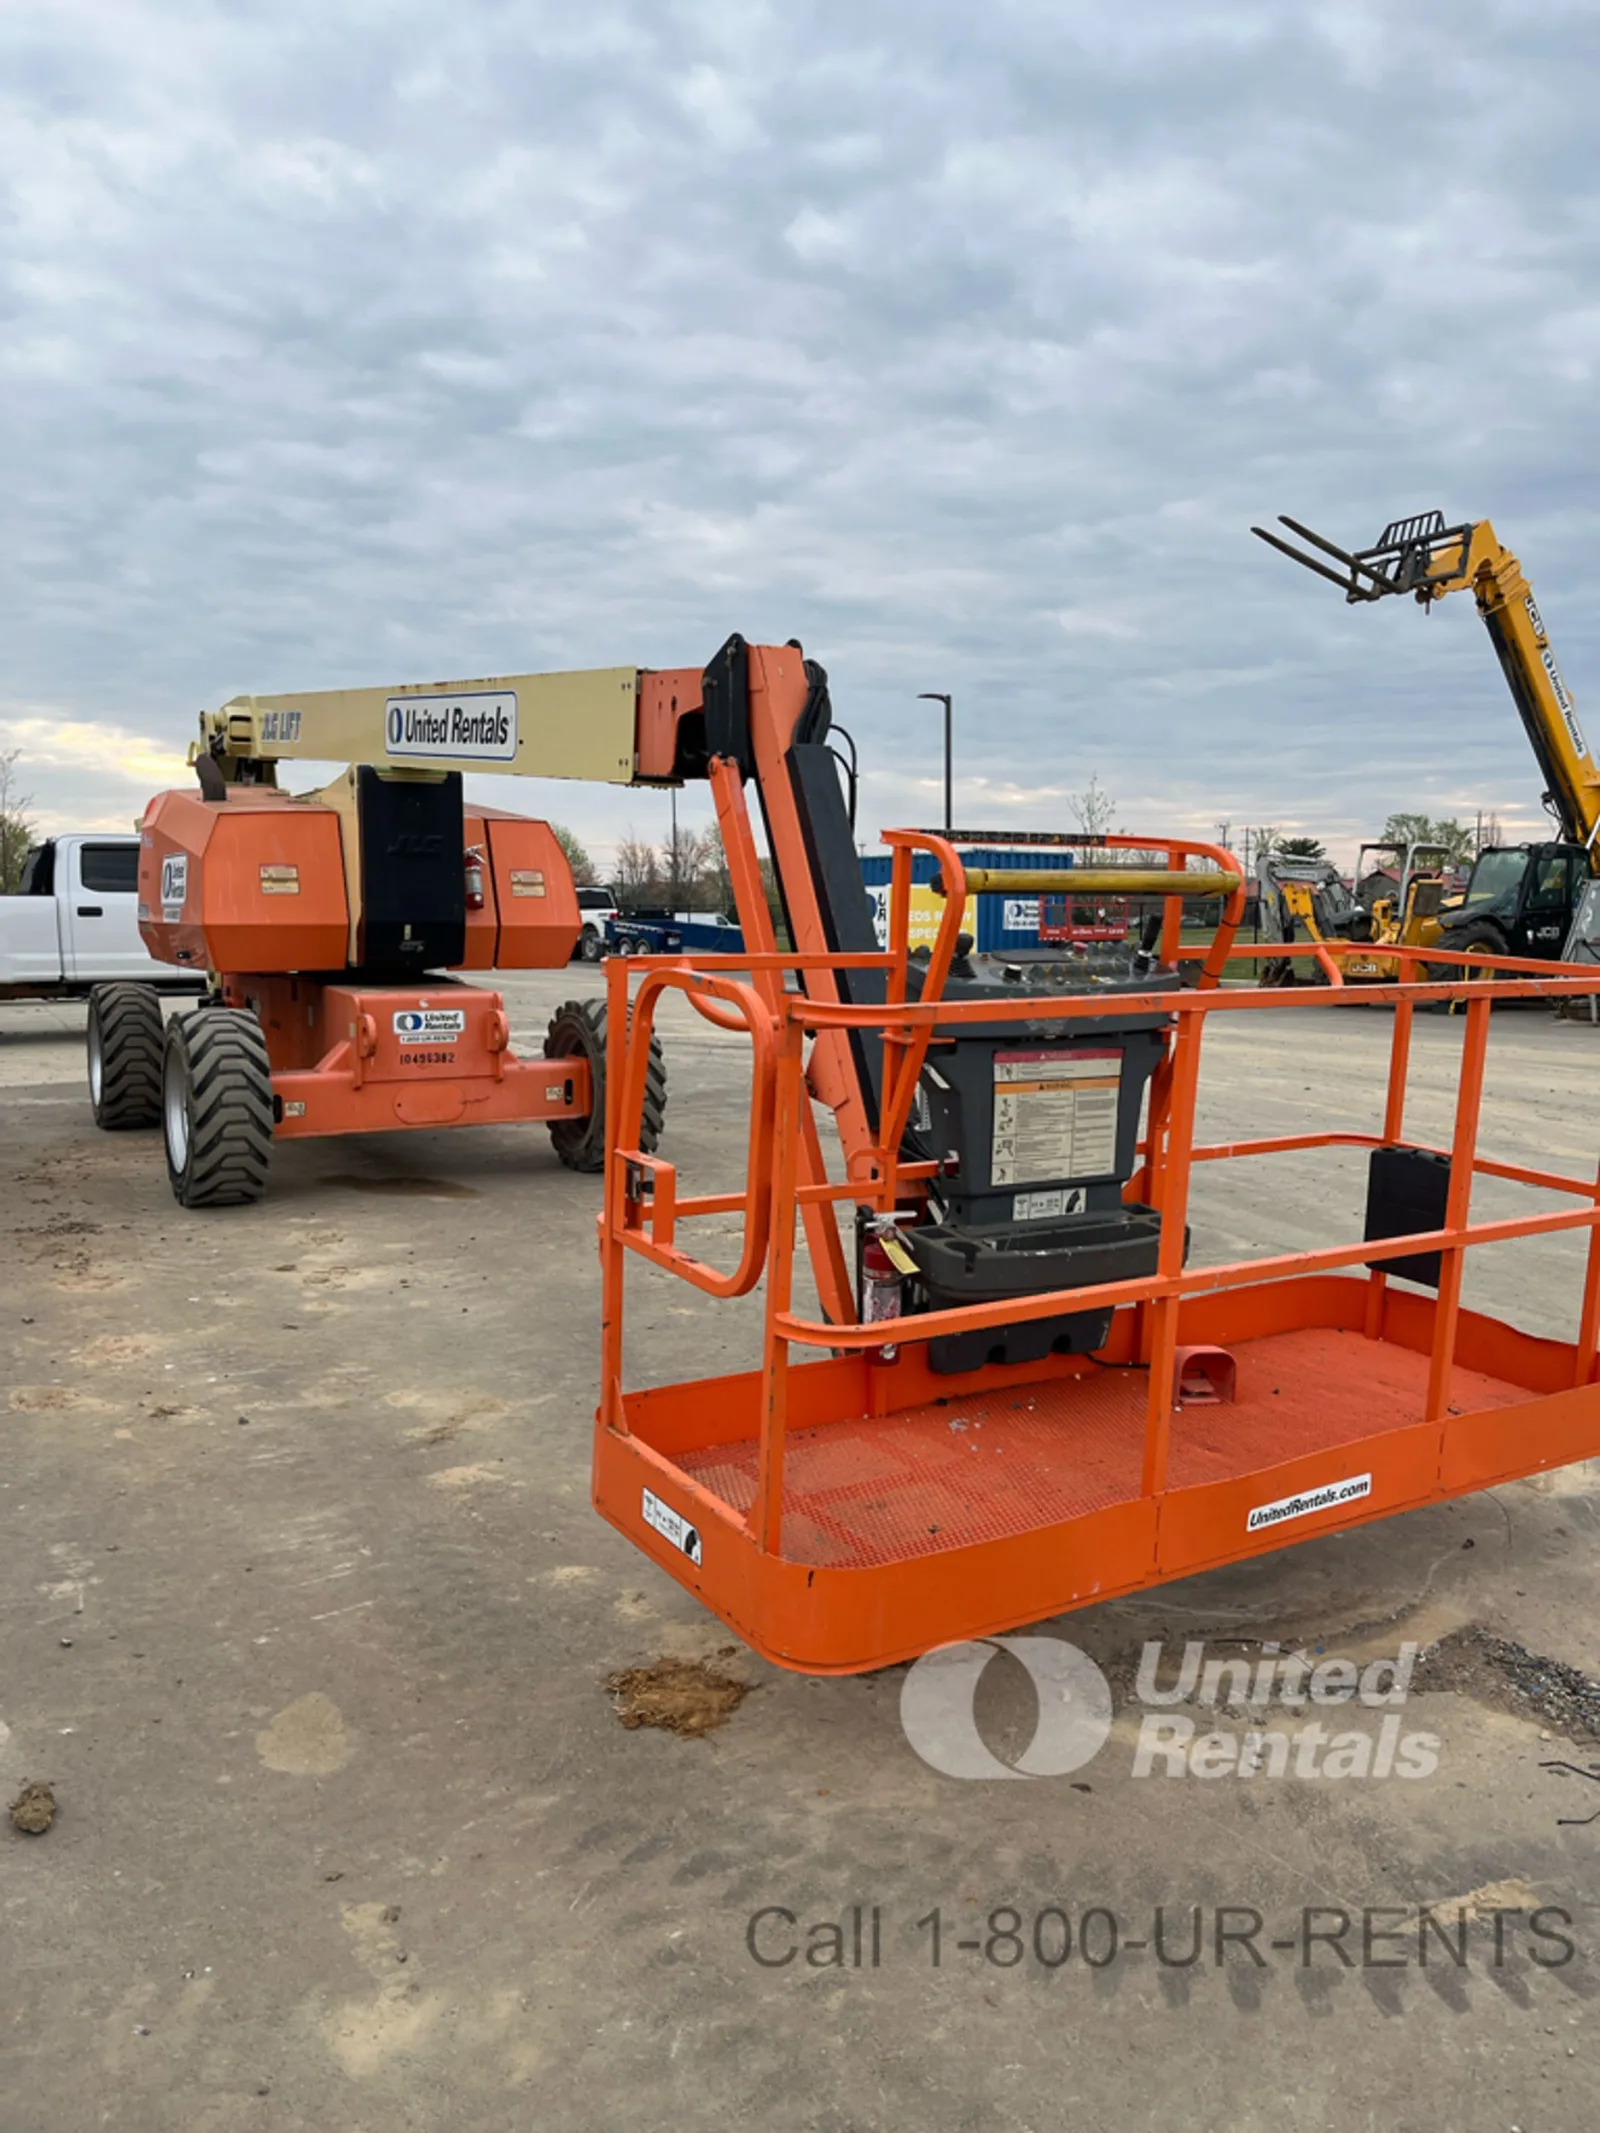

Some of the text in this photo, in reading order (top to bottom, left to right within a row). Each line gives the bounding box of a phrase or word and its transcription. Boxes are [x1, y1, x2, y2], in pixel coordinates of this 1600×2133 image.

[280, 710, 302, 741] LIFT
[405, 706, 509, 745] United Rentals
[1550, 670, 1583, 753] United Rentals
[1250, 1481, 1369, 1527] UnitedRentals.com
